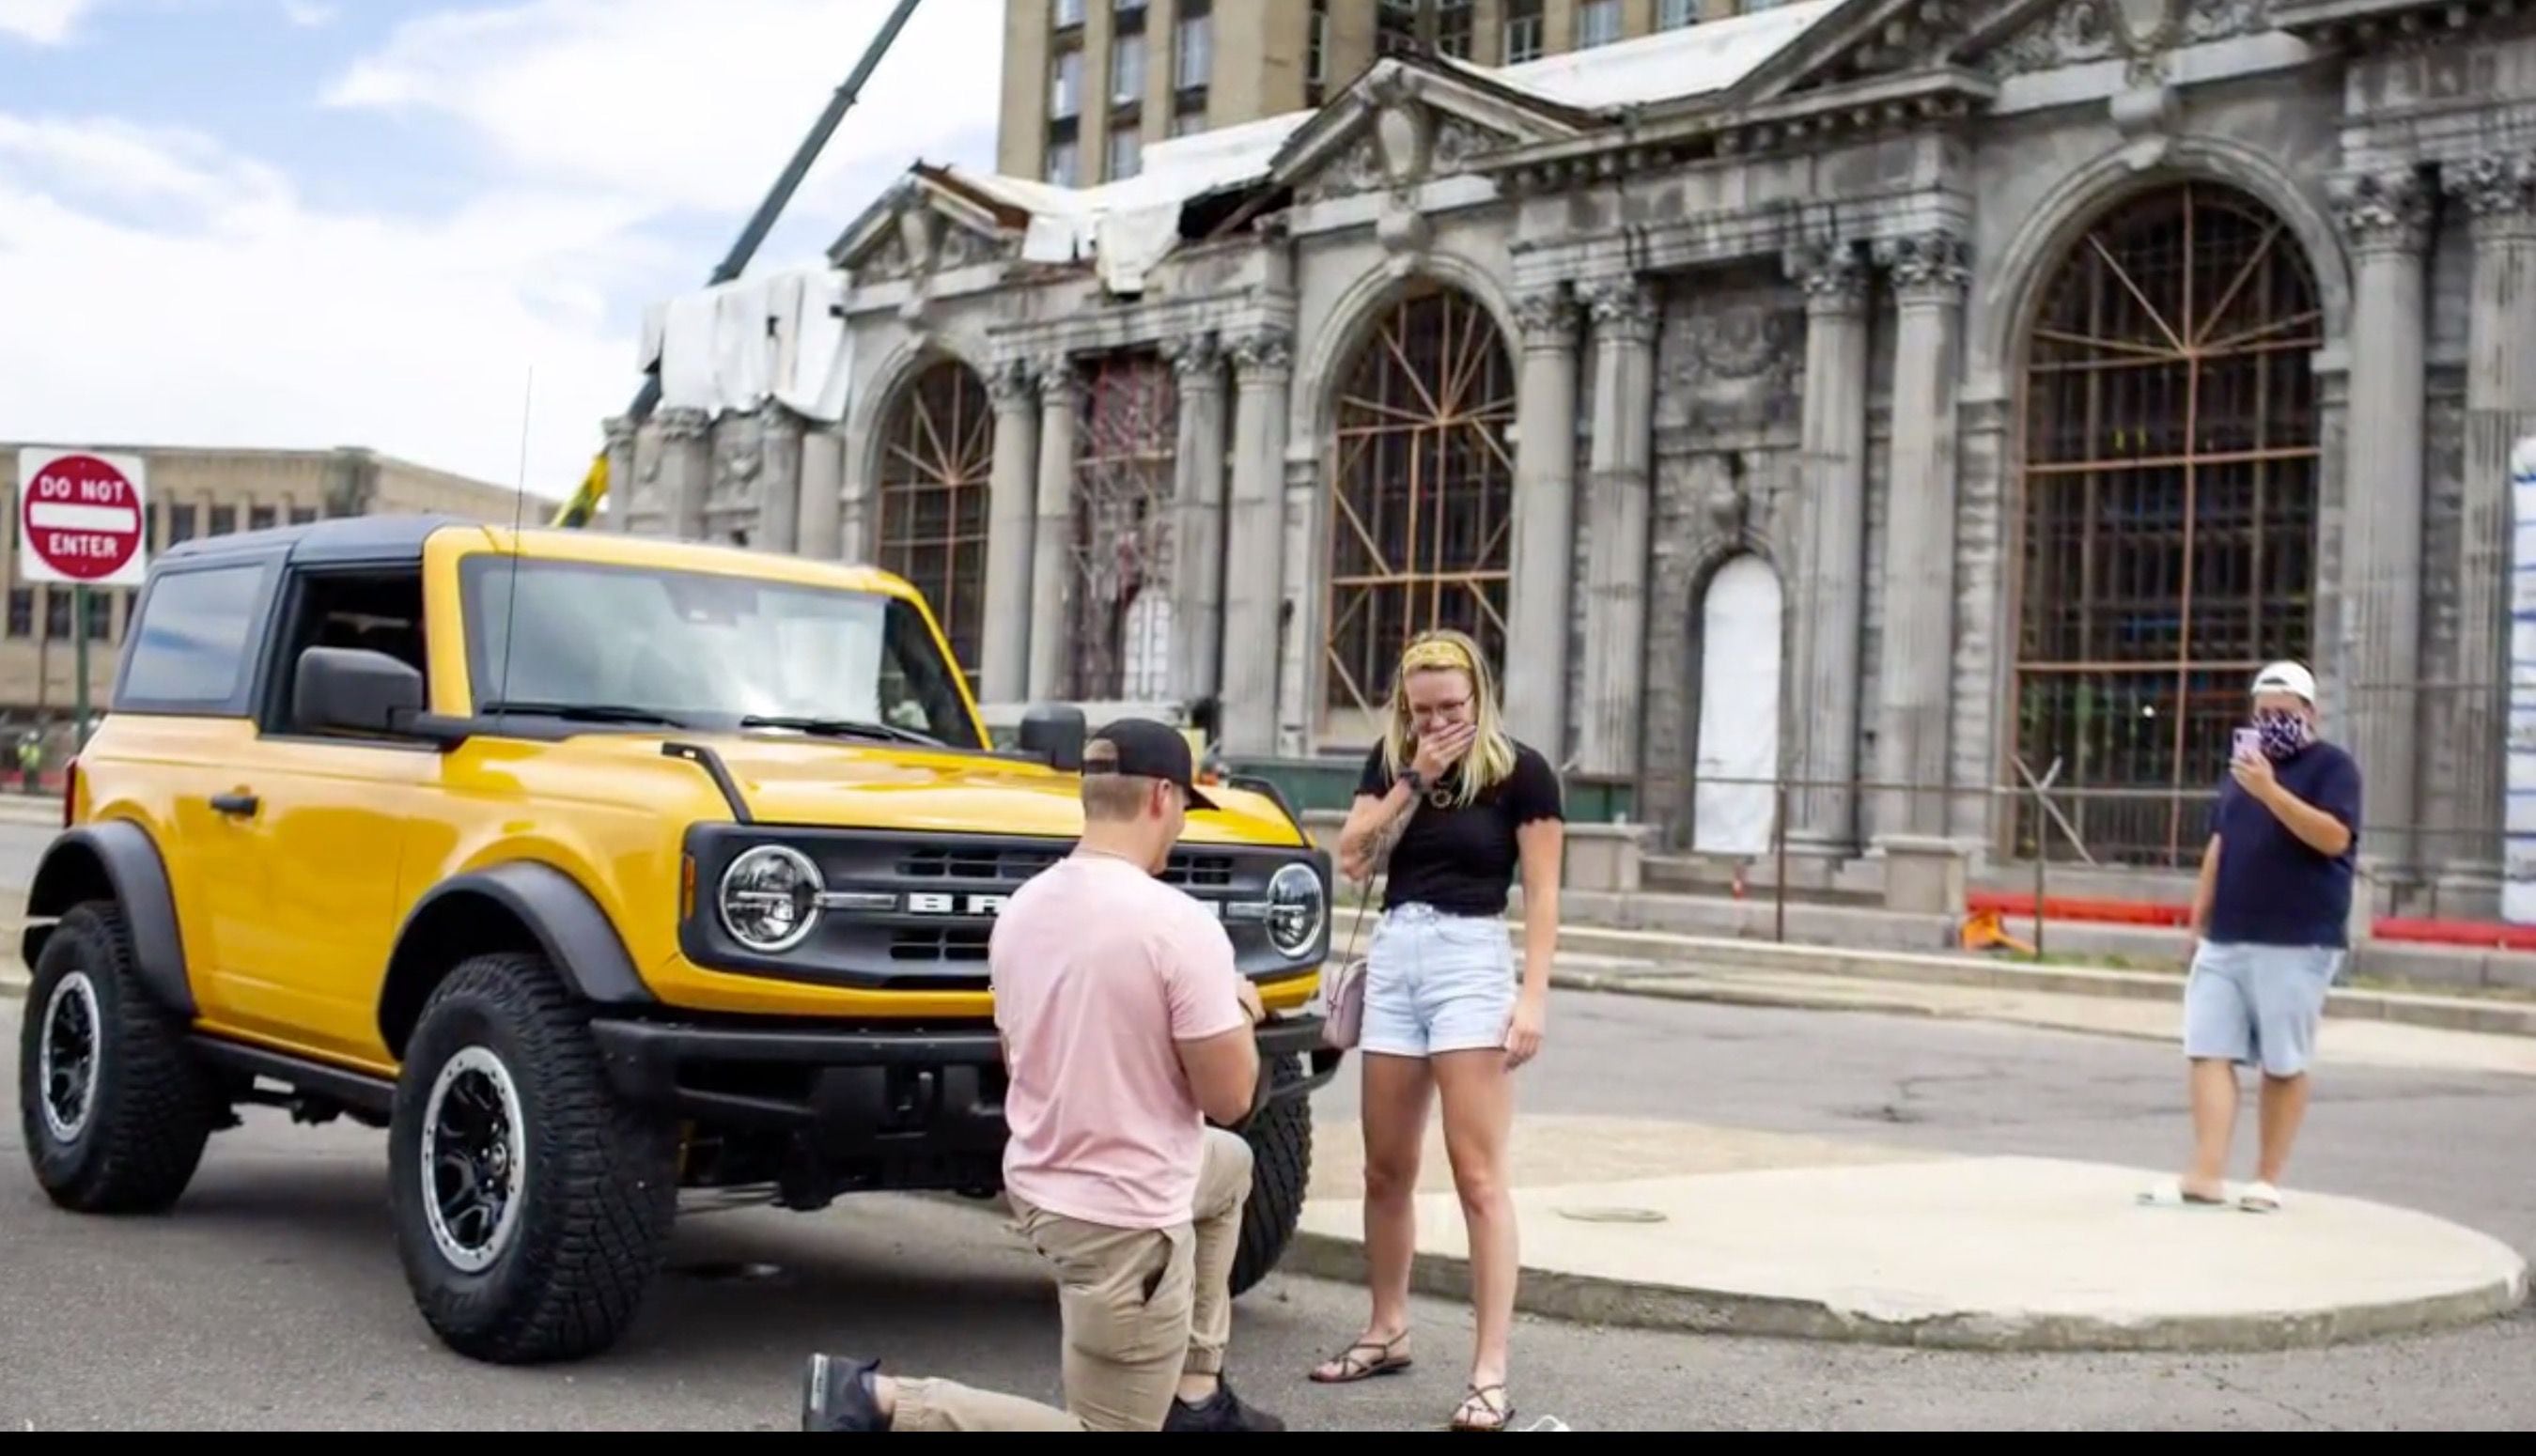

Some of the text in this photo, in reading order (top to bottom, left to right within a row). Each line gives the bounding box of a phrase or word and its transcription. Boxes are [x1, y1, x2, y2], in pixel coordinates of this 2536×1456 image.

[39, 475, 123, 502] DO NOT
[49, 533, 117, 557] ENTER
